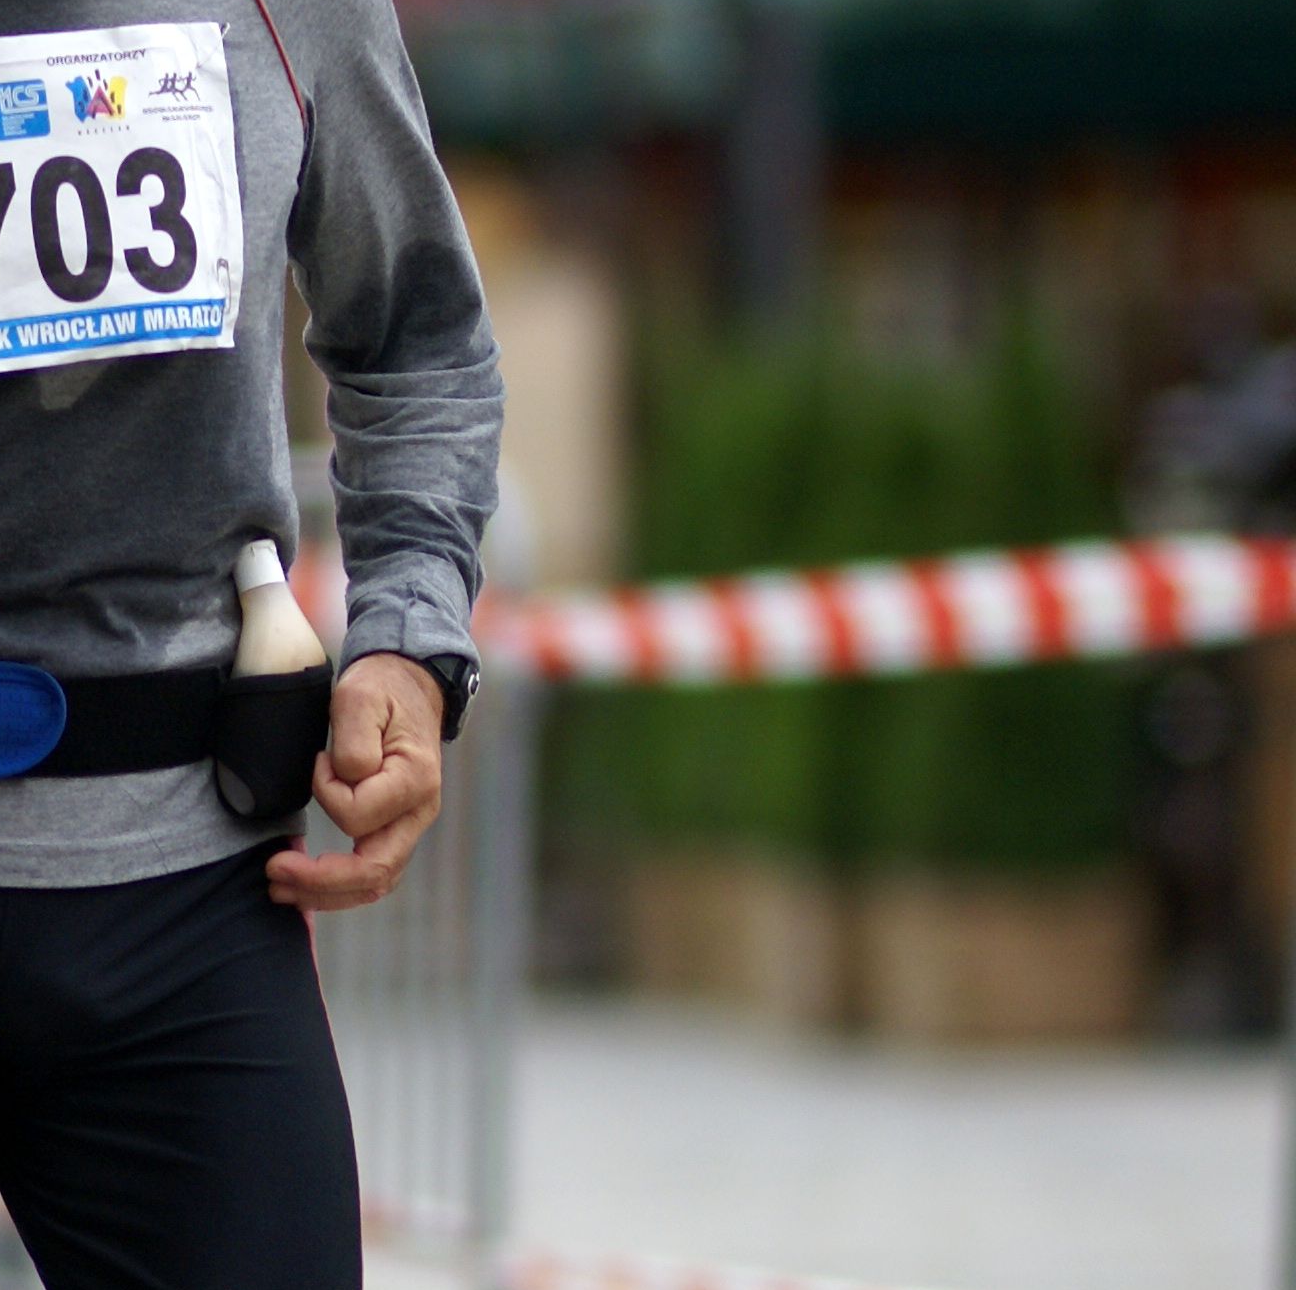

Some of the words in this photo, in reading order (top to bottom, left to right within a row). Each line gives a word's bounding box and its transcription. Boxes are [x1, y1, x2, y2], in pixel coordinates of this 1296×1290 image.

[46, 49, 147, 66] ORGANIZATORZY
[18, 312, 136, 346] WROCŁAW
[144, 304, 222, 330] MARATO
